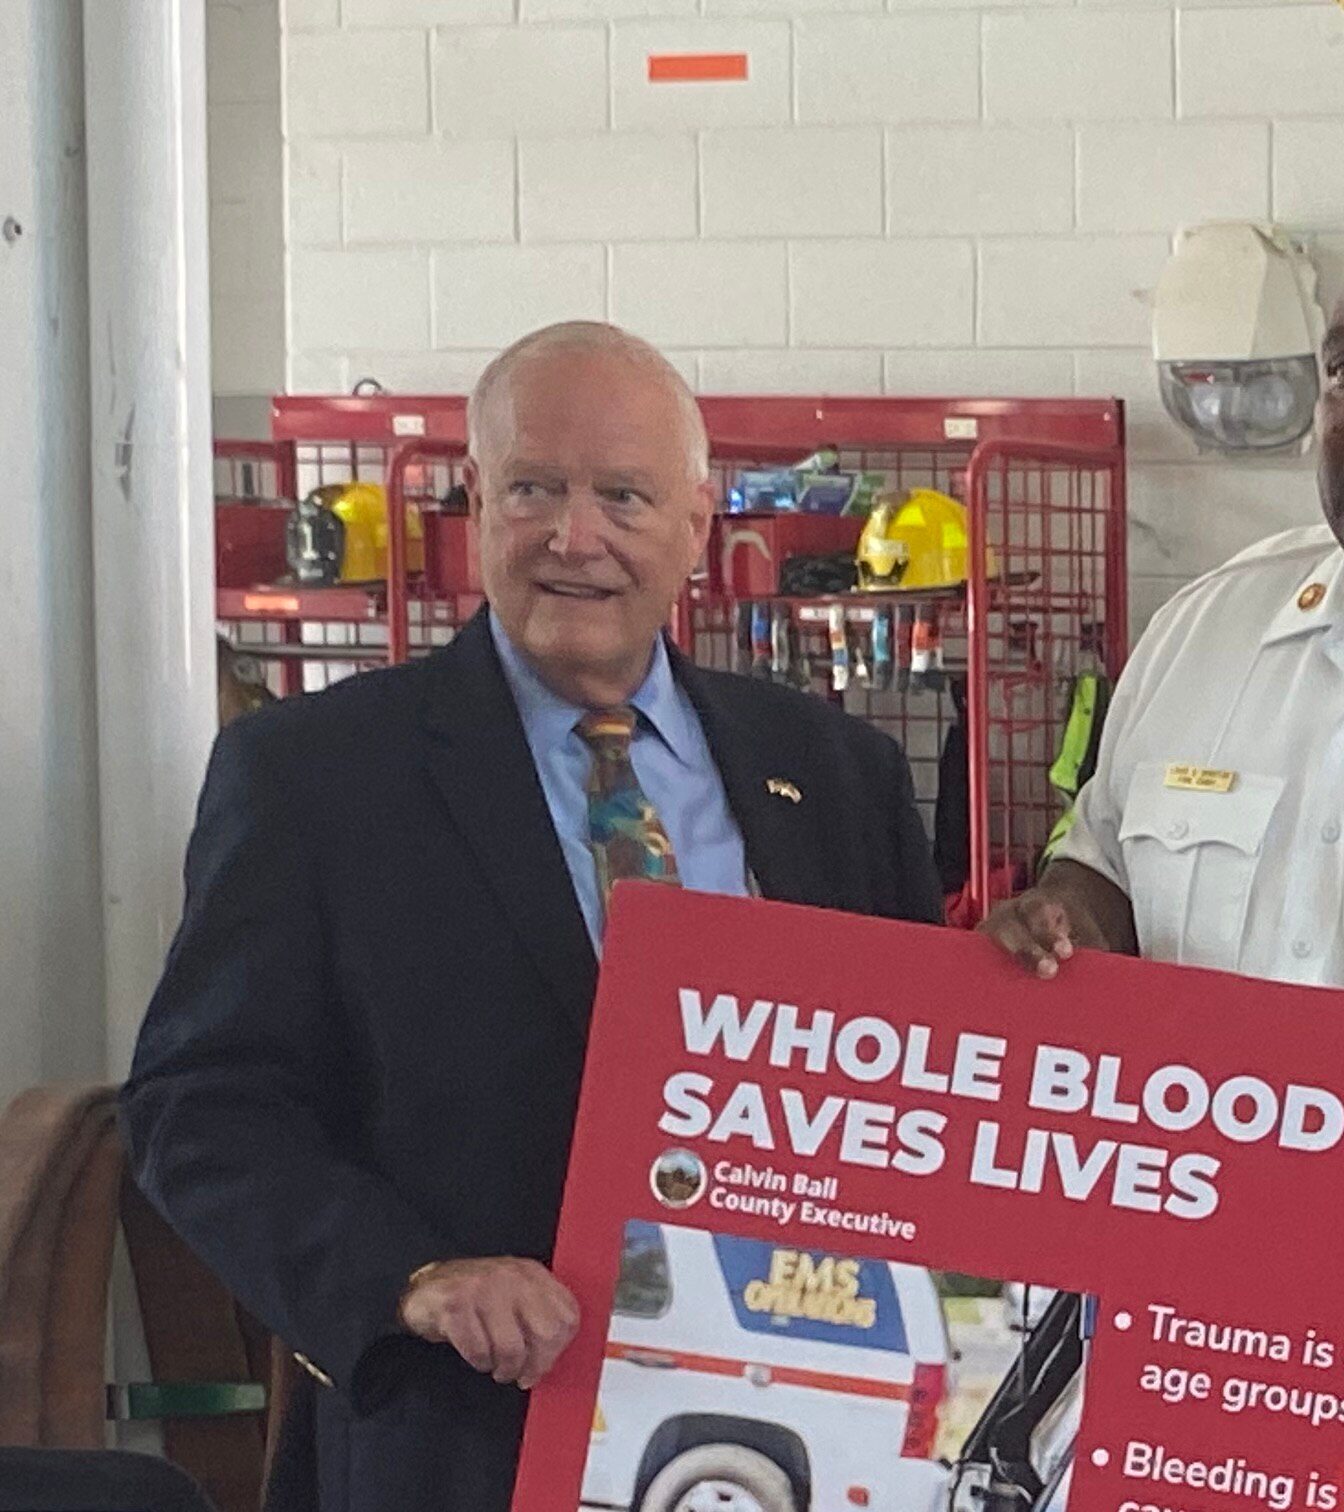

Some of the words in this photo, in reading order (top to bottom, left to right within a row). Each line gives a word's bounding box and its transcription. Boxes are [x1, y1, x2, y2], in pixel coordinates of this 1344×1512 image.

[679, 989, 1006, 1101] WHOLE
[658, 1072, 947, 1174] SAVES
[970, 1121, 1220, 1218] LIVES
[715, 1161, 786, 1191] Calvin
[793, 1174, 837, 1200] Ball
[710, 1187, 796, 1224] County
[800, 1202, 915, 1239] Executive
[769, 1249, 861, 1298] EMS
[1148, 1305, 1290, 1360] Trauma
[1303, 1330, 1333, 1367] is
[1141, 1365, 1210, 1402] age
[1124, 1442, 1293, 1509] Bleeding
[1306, 1472, 1337, 1509] is
